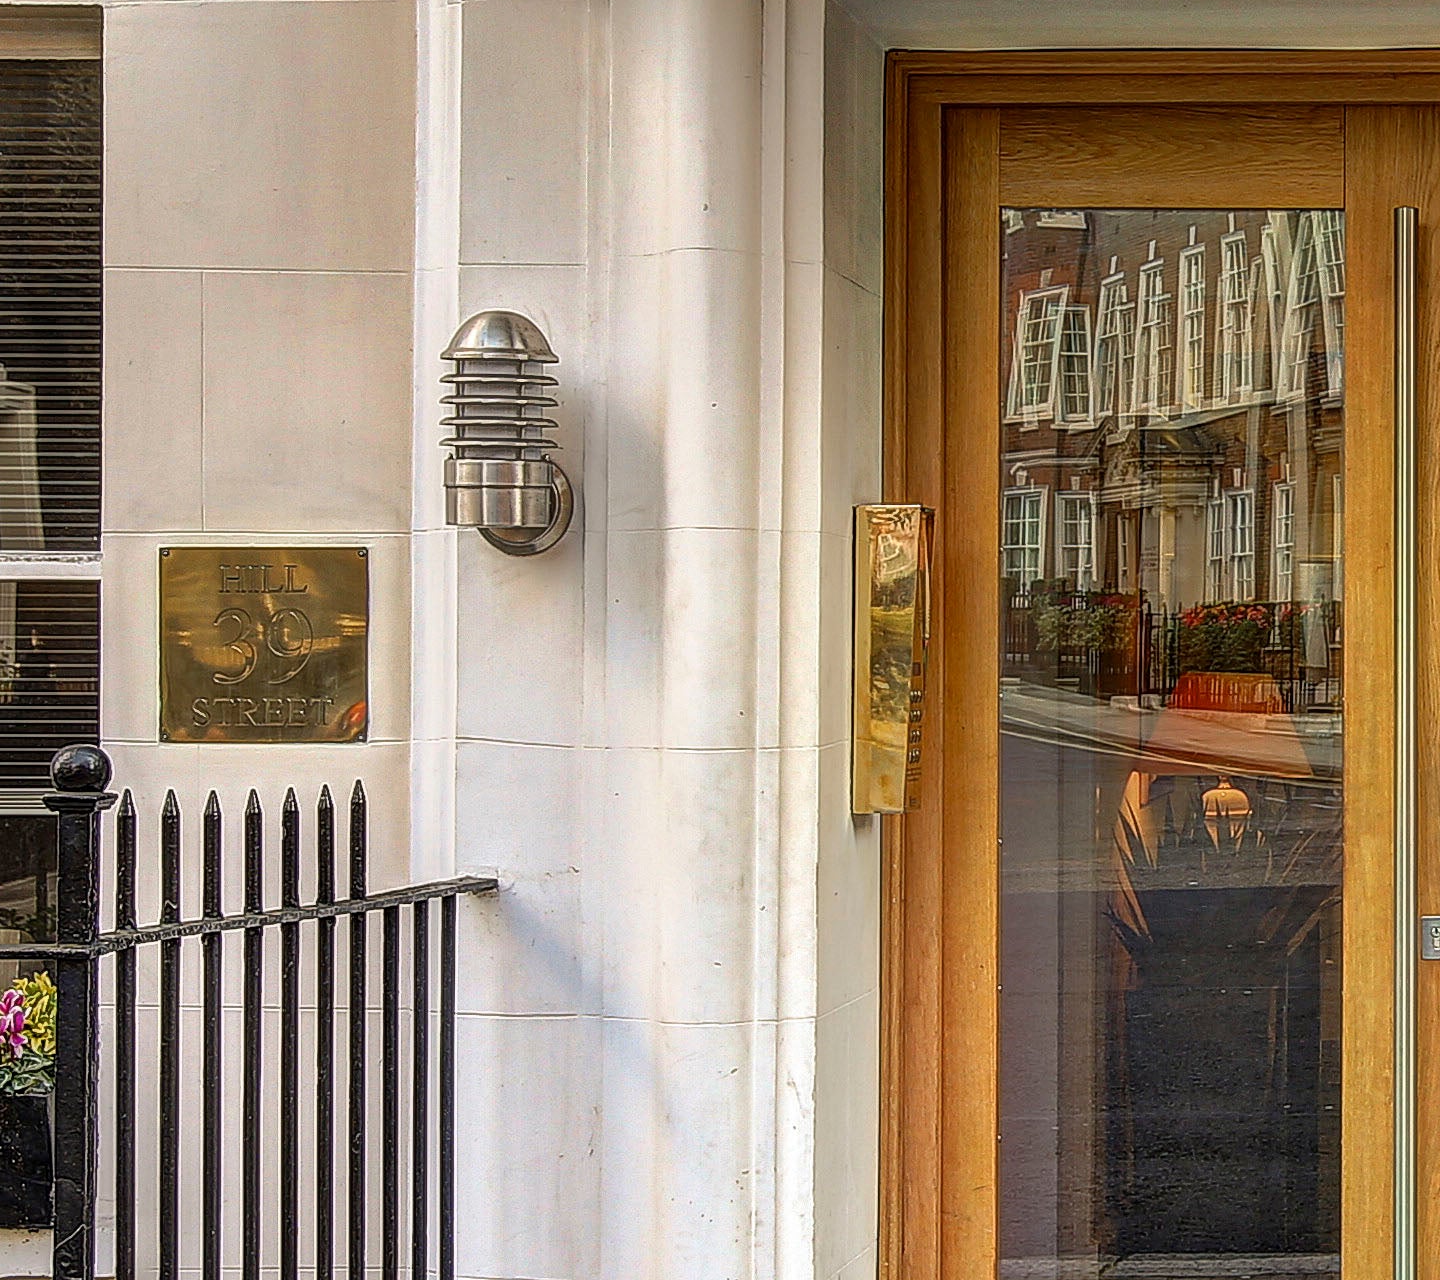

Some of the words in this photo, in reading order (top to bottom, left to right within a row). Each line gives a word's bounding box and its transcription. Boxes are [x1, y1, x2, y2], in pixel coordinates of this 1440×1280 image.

[218, 564, 309, 594] HILL
[211, 606, 314, 686] 39
[191, 695, 335, 728] STREET
